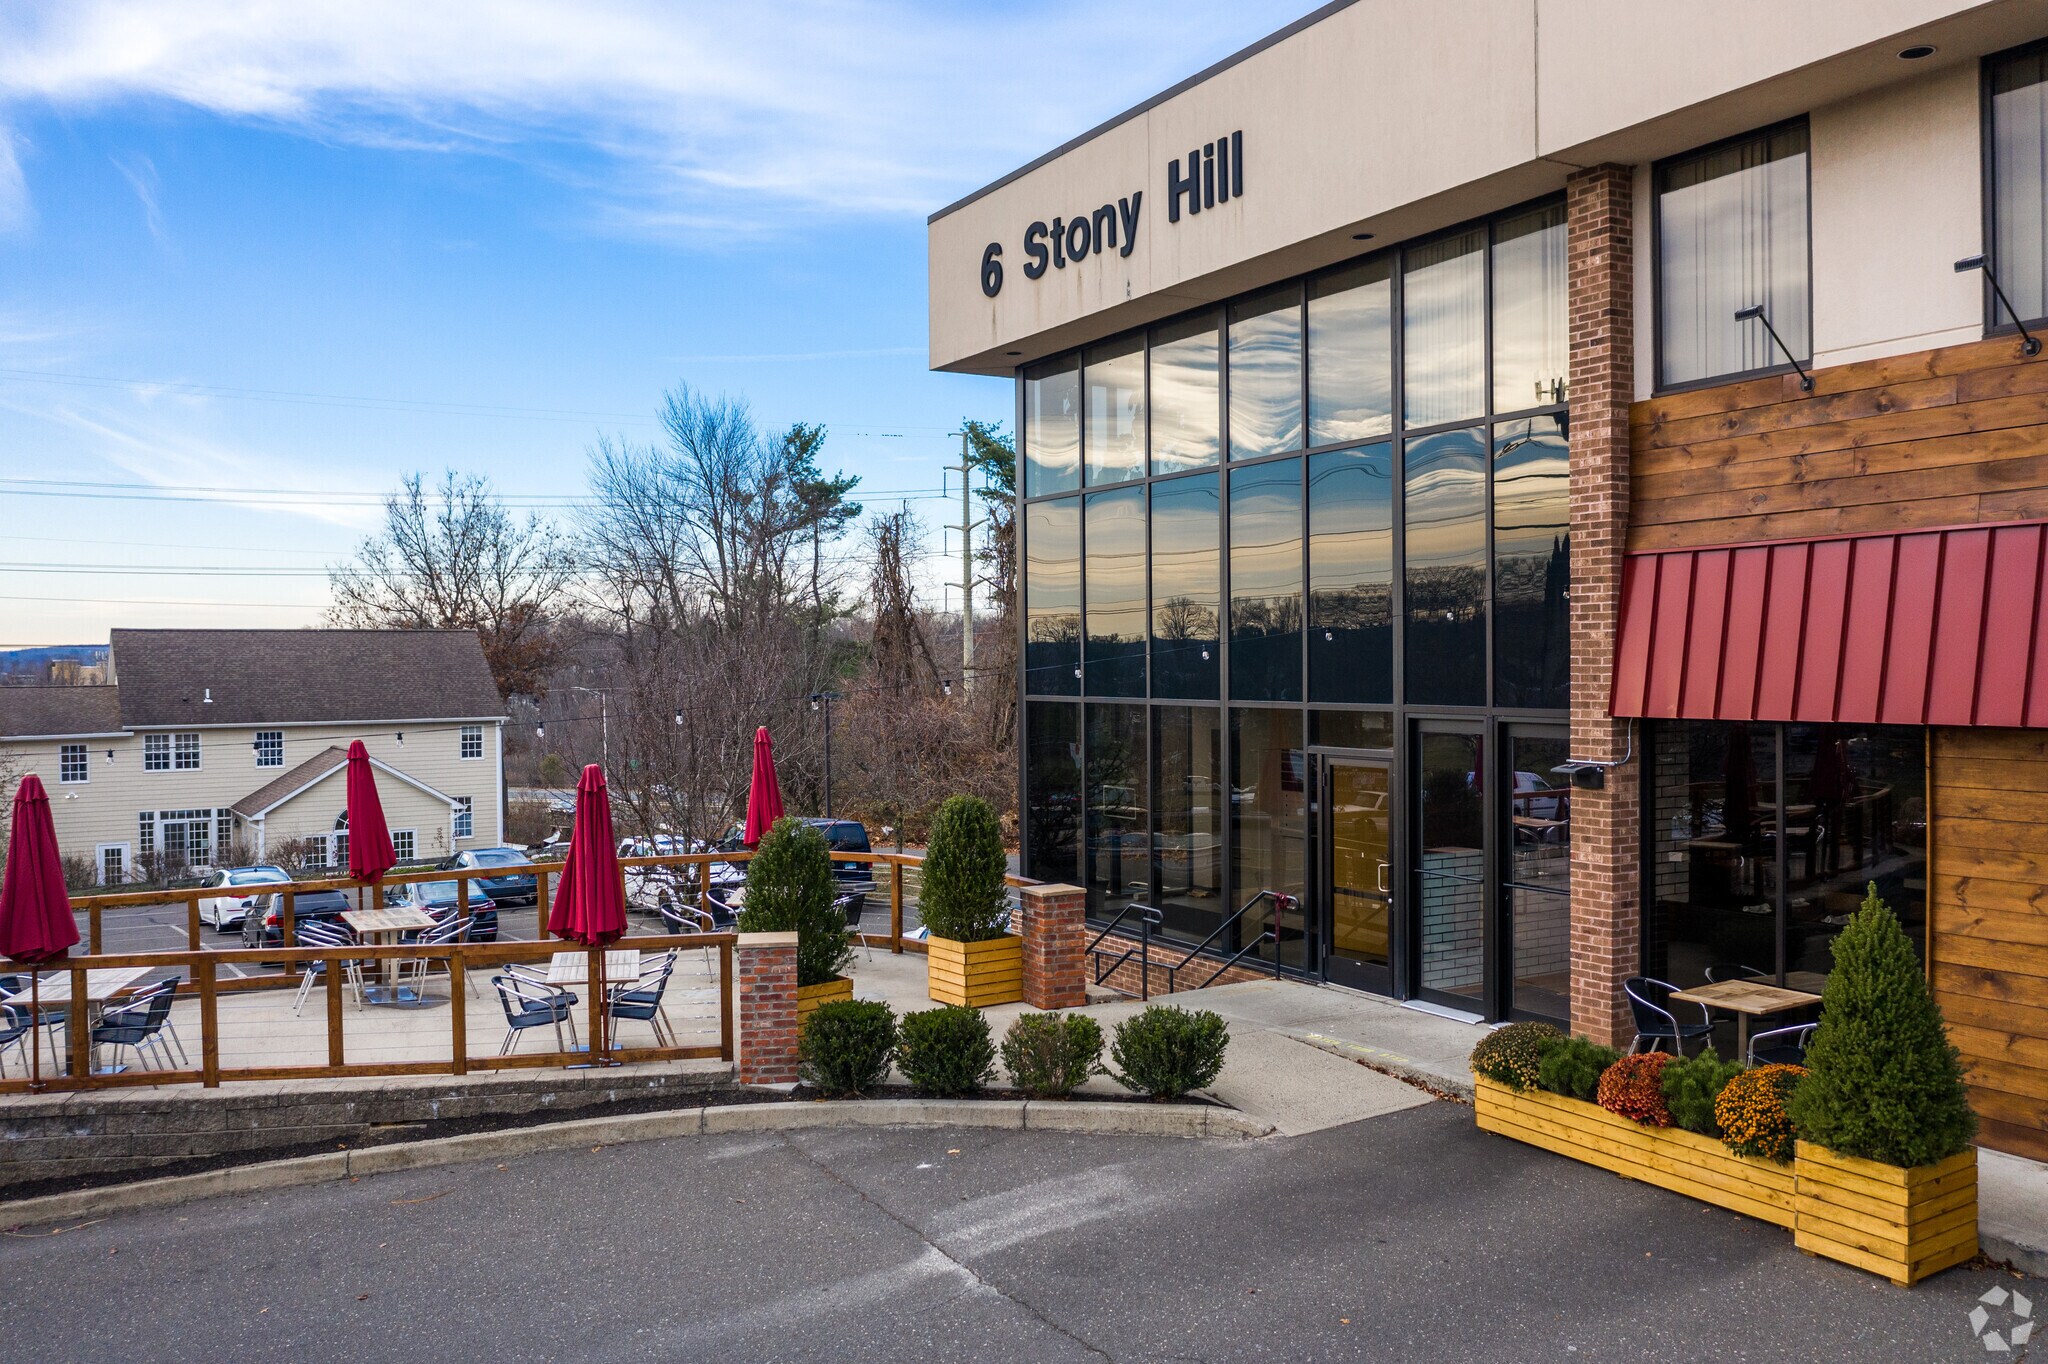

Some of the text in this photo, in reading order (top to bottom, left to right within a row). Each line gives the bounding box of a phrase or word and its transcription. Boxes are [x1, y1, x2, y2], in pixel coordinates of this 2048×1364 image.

[981, 130, 1242, 297] 6 Stony Hill
